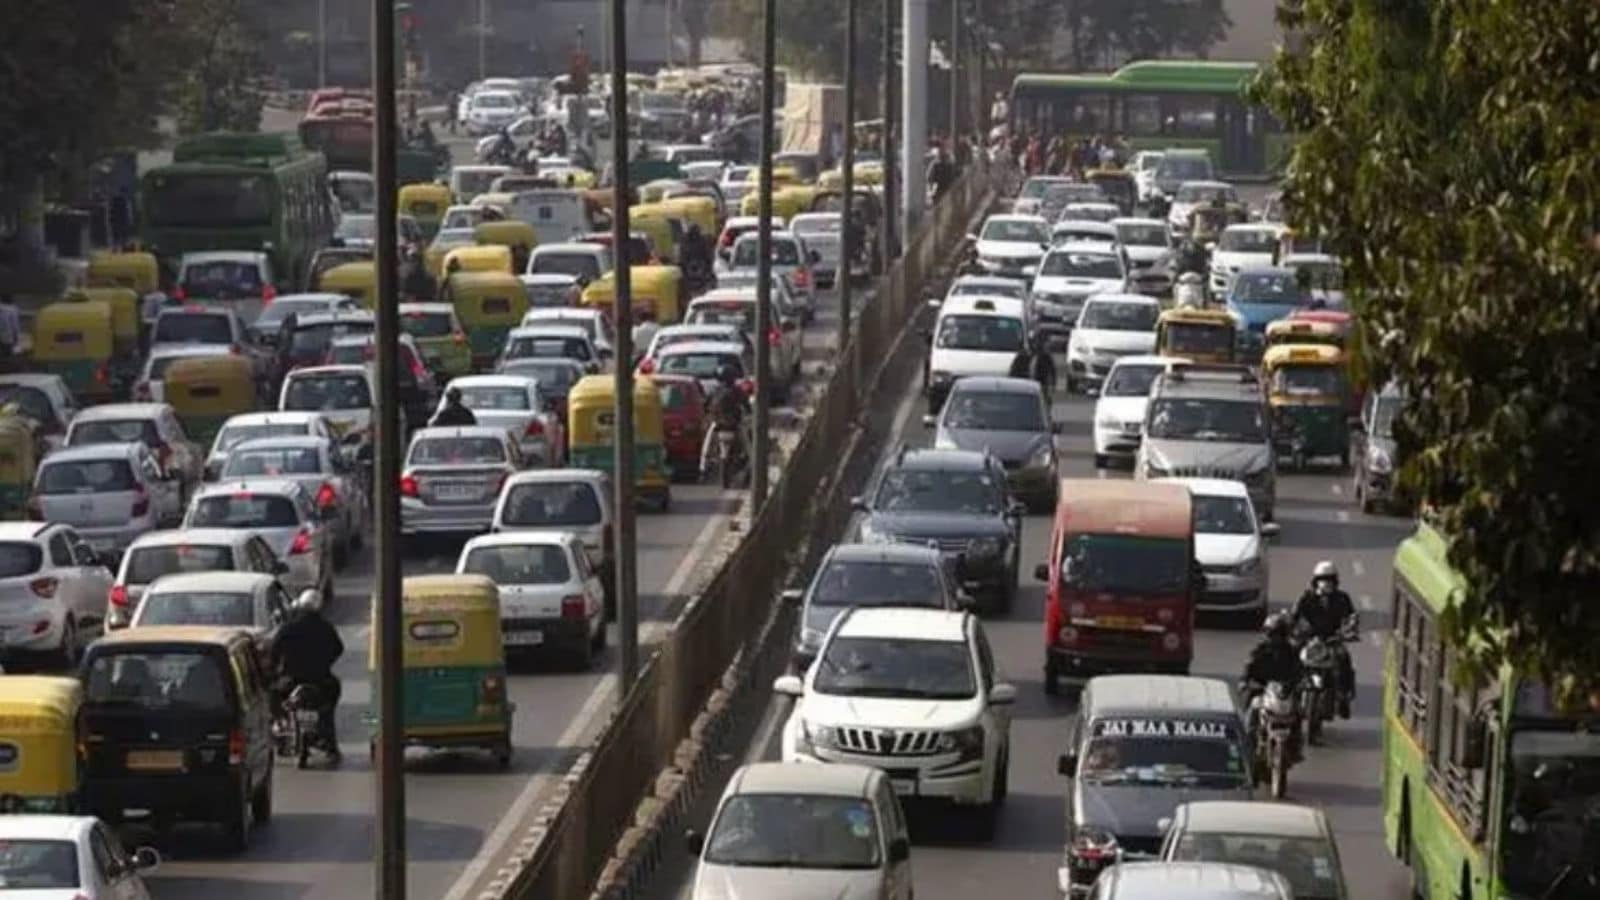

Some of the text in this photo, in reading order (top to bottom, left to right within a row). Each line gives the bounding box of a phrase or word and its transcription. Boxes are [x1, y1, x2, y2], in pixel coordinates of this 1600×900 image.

[1102, 720, 1226, 737] JAI MAA KAALI
